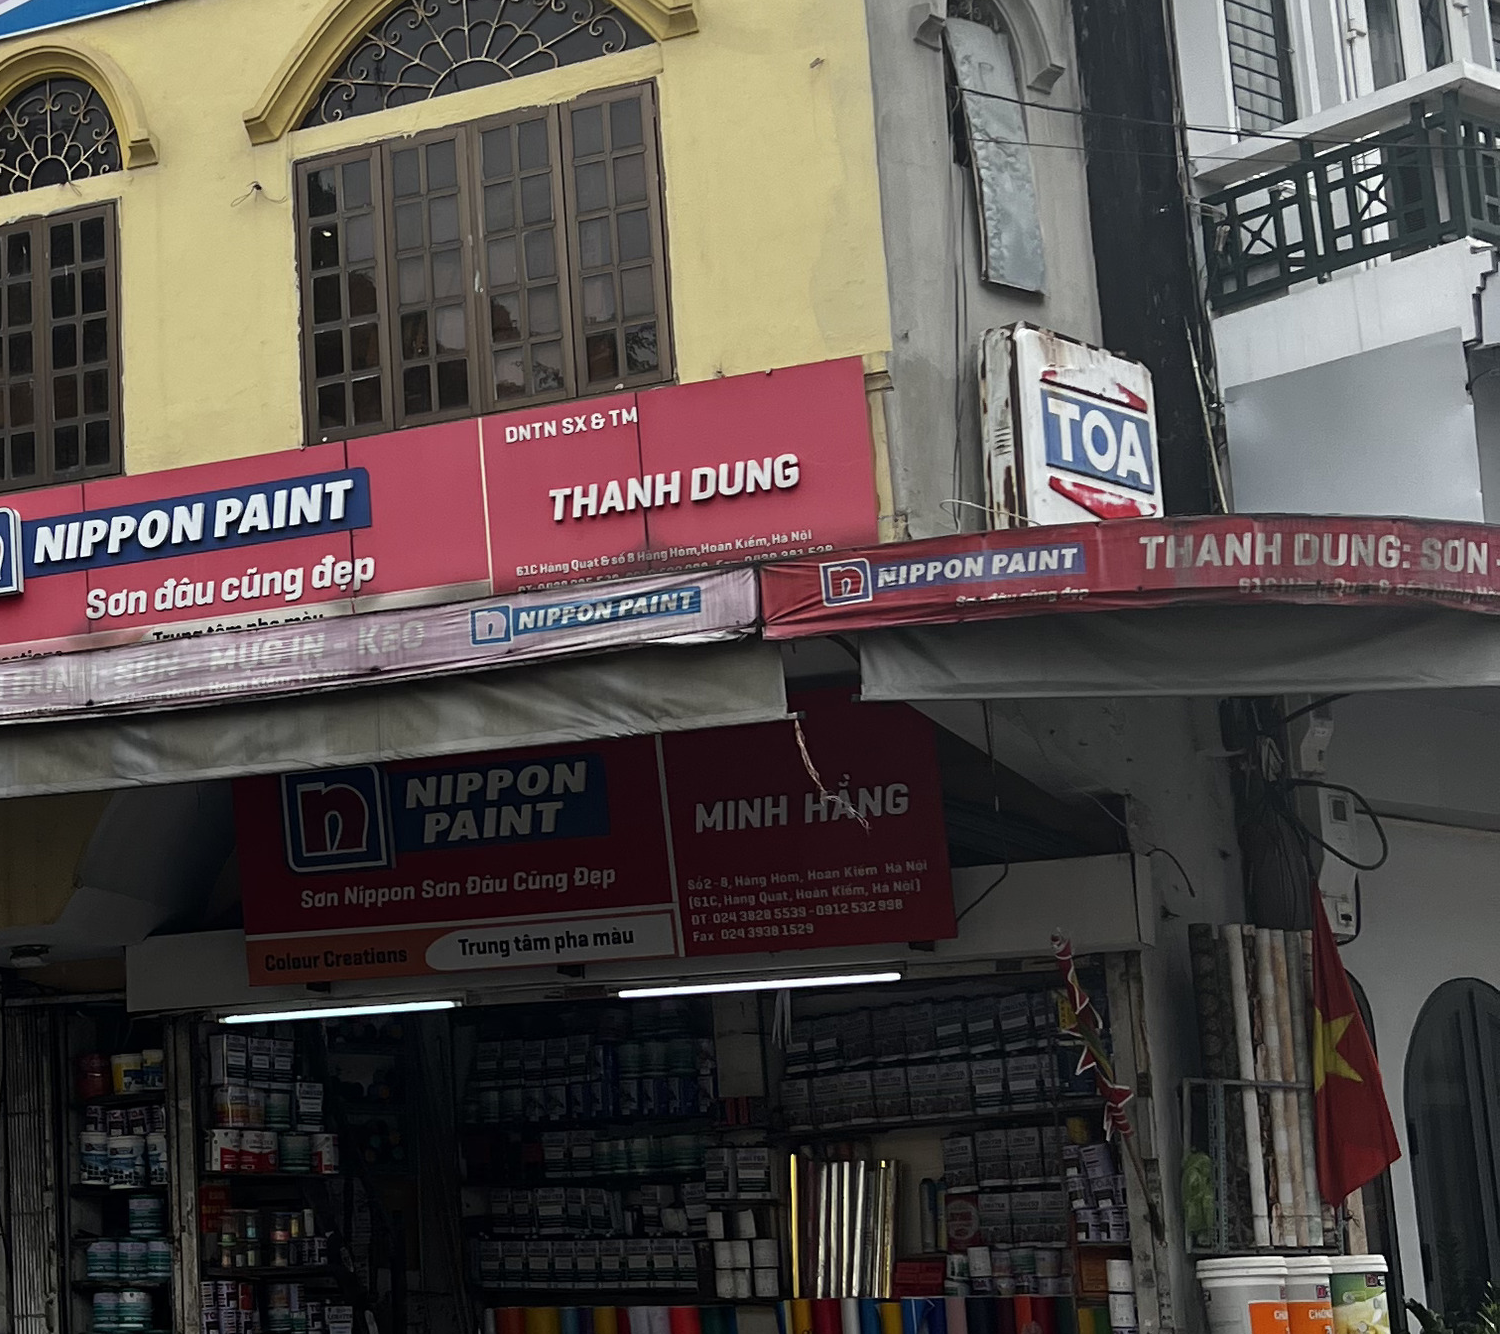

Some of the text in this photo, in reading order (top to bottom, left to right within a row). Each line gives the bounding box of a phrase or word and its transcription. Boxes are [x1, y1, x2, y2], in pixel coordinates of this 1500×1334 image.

[505, 406, 638, 444] DNTN SX & TM
[1046, 396, 1152, 486] TOA
[549, 453, 800, 522] THANH DUNG
[33, 478, 356, 568] NIPPON PAINT
[516, 564, 538, 578] 61C
[540, 559, 569, 579] Hàng
[571, 556, 600, 575] Quạt
[877, 546, 1079, 589] NIPPON PAINT
[1138, 531, 1490, 577] THANH DUNG: SƠN
[86, 553, 376, 621] Sơn đâu cũng đẹp
[518, 590, 696, 631] NIPPON PAINT
[357, 621, 426, 656] KEO
[404, 760, 588, 810] NIPPON
[695, 773, 910, 835] MINH HẰNG
[423, 801, 565, 845] PAINT
[300, 888, 339, 910] Sơn
[421, 878, 461, 900] Sơn
[465, 871, 508, 896] Đâu
[513, 867, 569, 893] Cũng
[572, 864, 617, 892] Đẹp
[265, 924, 635, 973] Colour Creations Trung tâm pha màu
[781, 922, 815, 936] 1529
